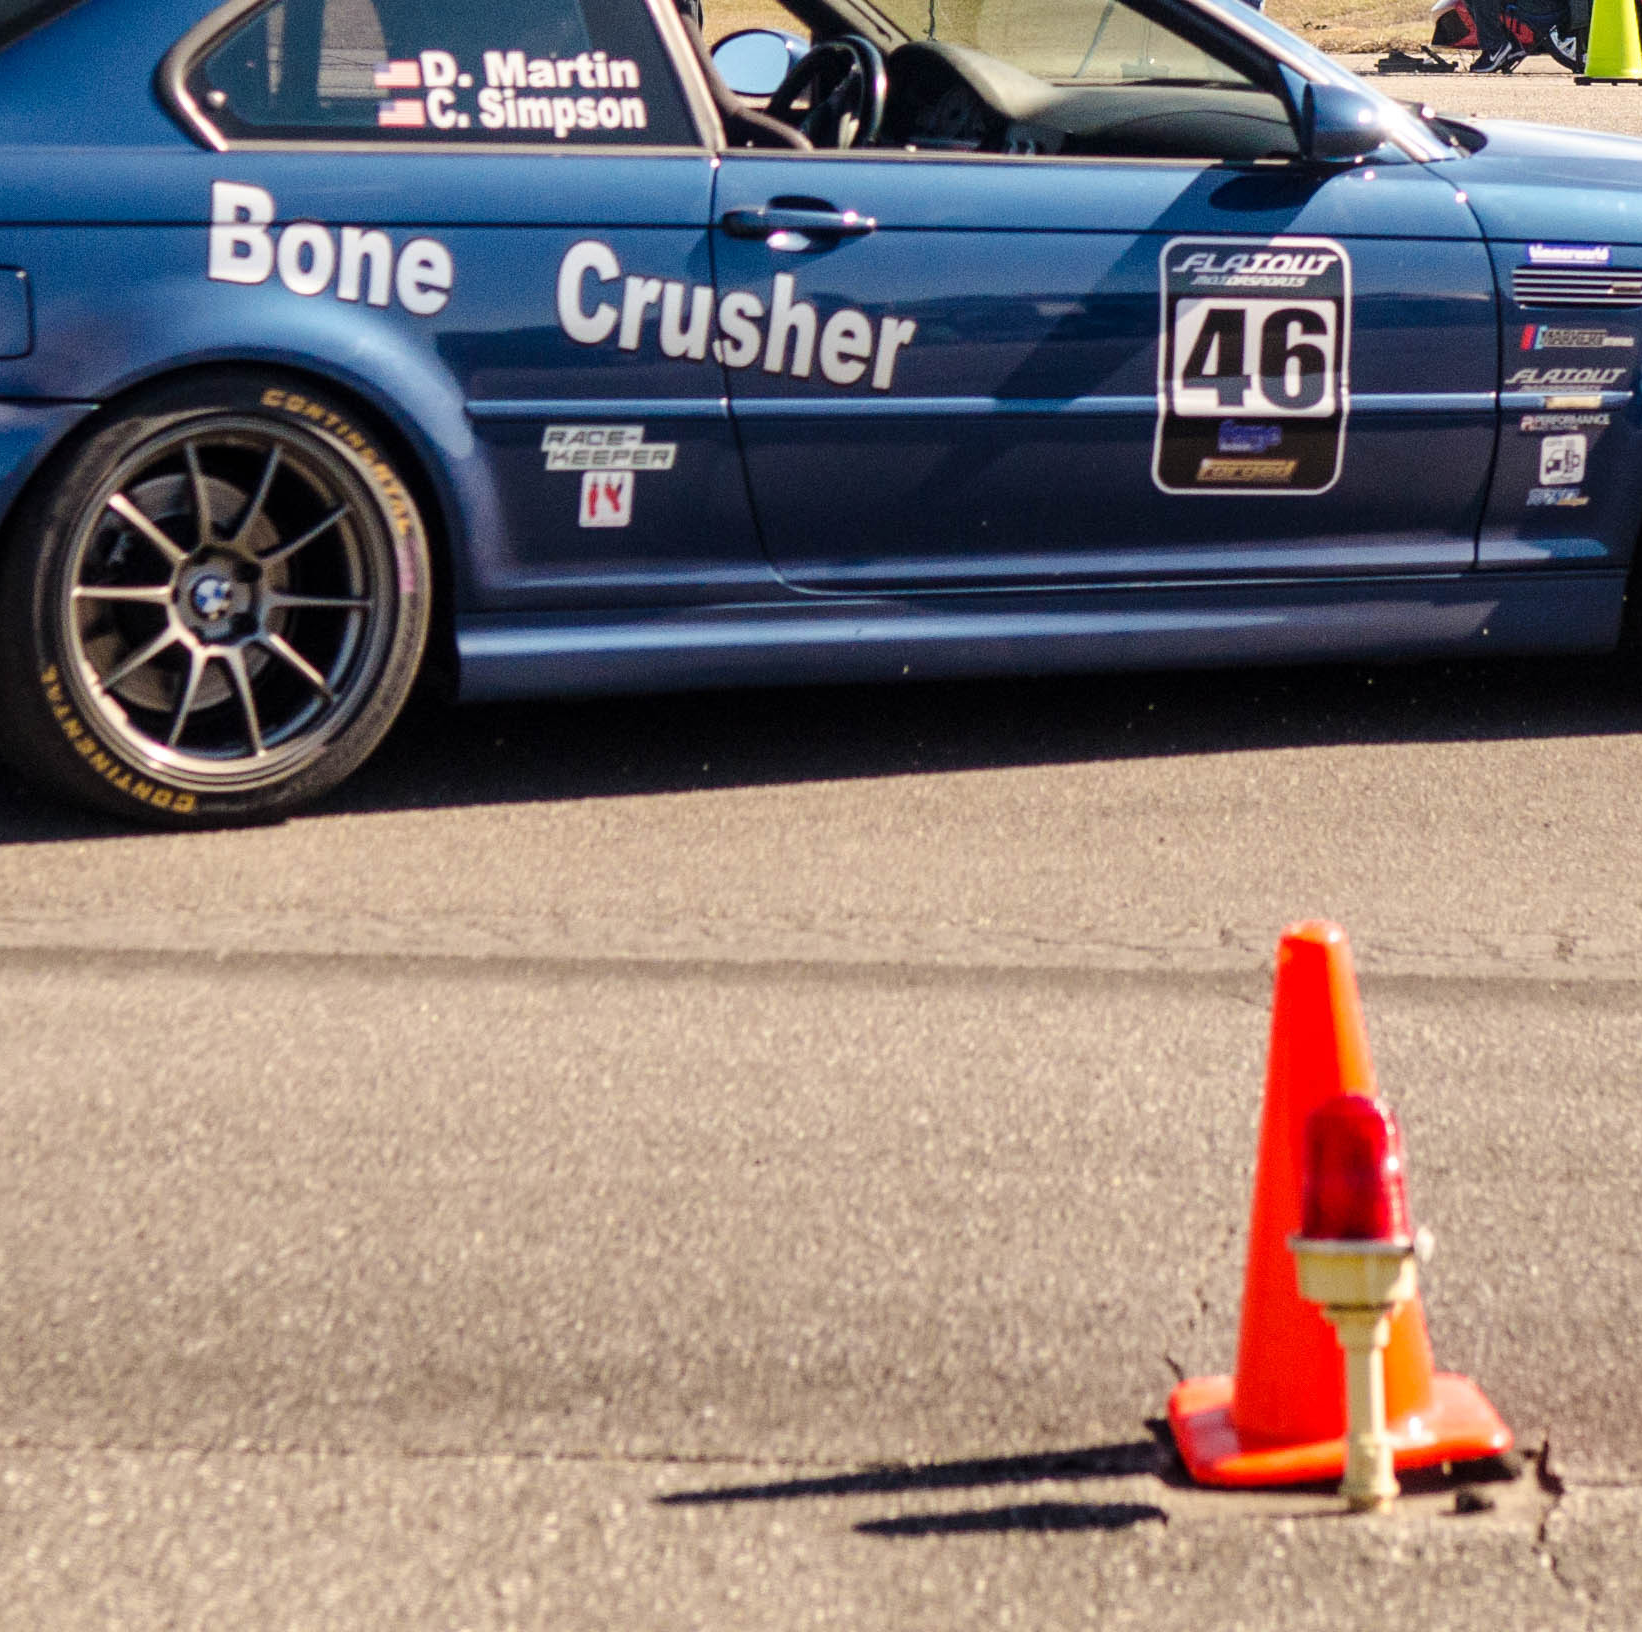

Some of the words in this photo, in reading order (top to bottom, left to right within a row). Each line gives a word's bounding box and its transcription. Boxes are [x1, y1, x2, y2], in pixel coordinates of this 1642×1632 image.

[419, 49, 474, 89] D.
[483, 49, 641, 89] Martin
[425, 87, 472, 130] C.
[477, 87, 648, 139] Simpson
[209, 181, 453, 315] Bone
[556, 240, 917, 391] Crusher
[1172, 252, 1339, 276] FLATOUT
[1182, 308, 1329, 411] 46
[1503, 368, 1627, 385] FLATOUT
[551, 448, 671, 466] KEEPER
[40, 663, 197, 814] CONTINENTAL
